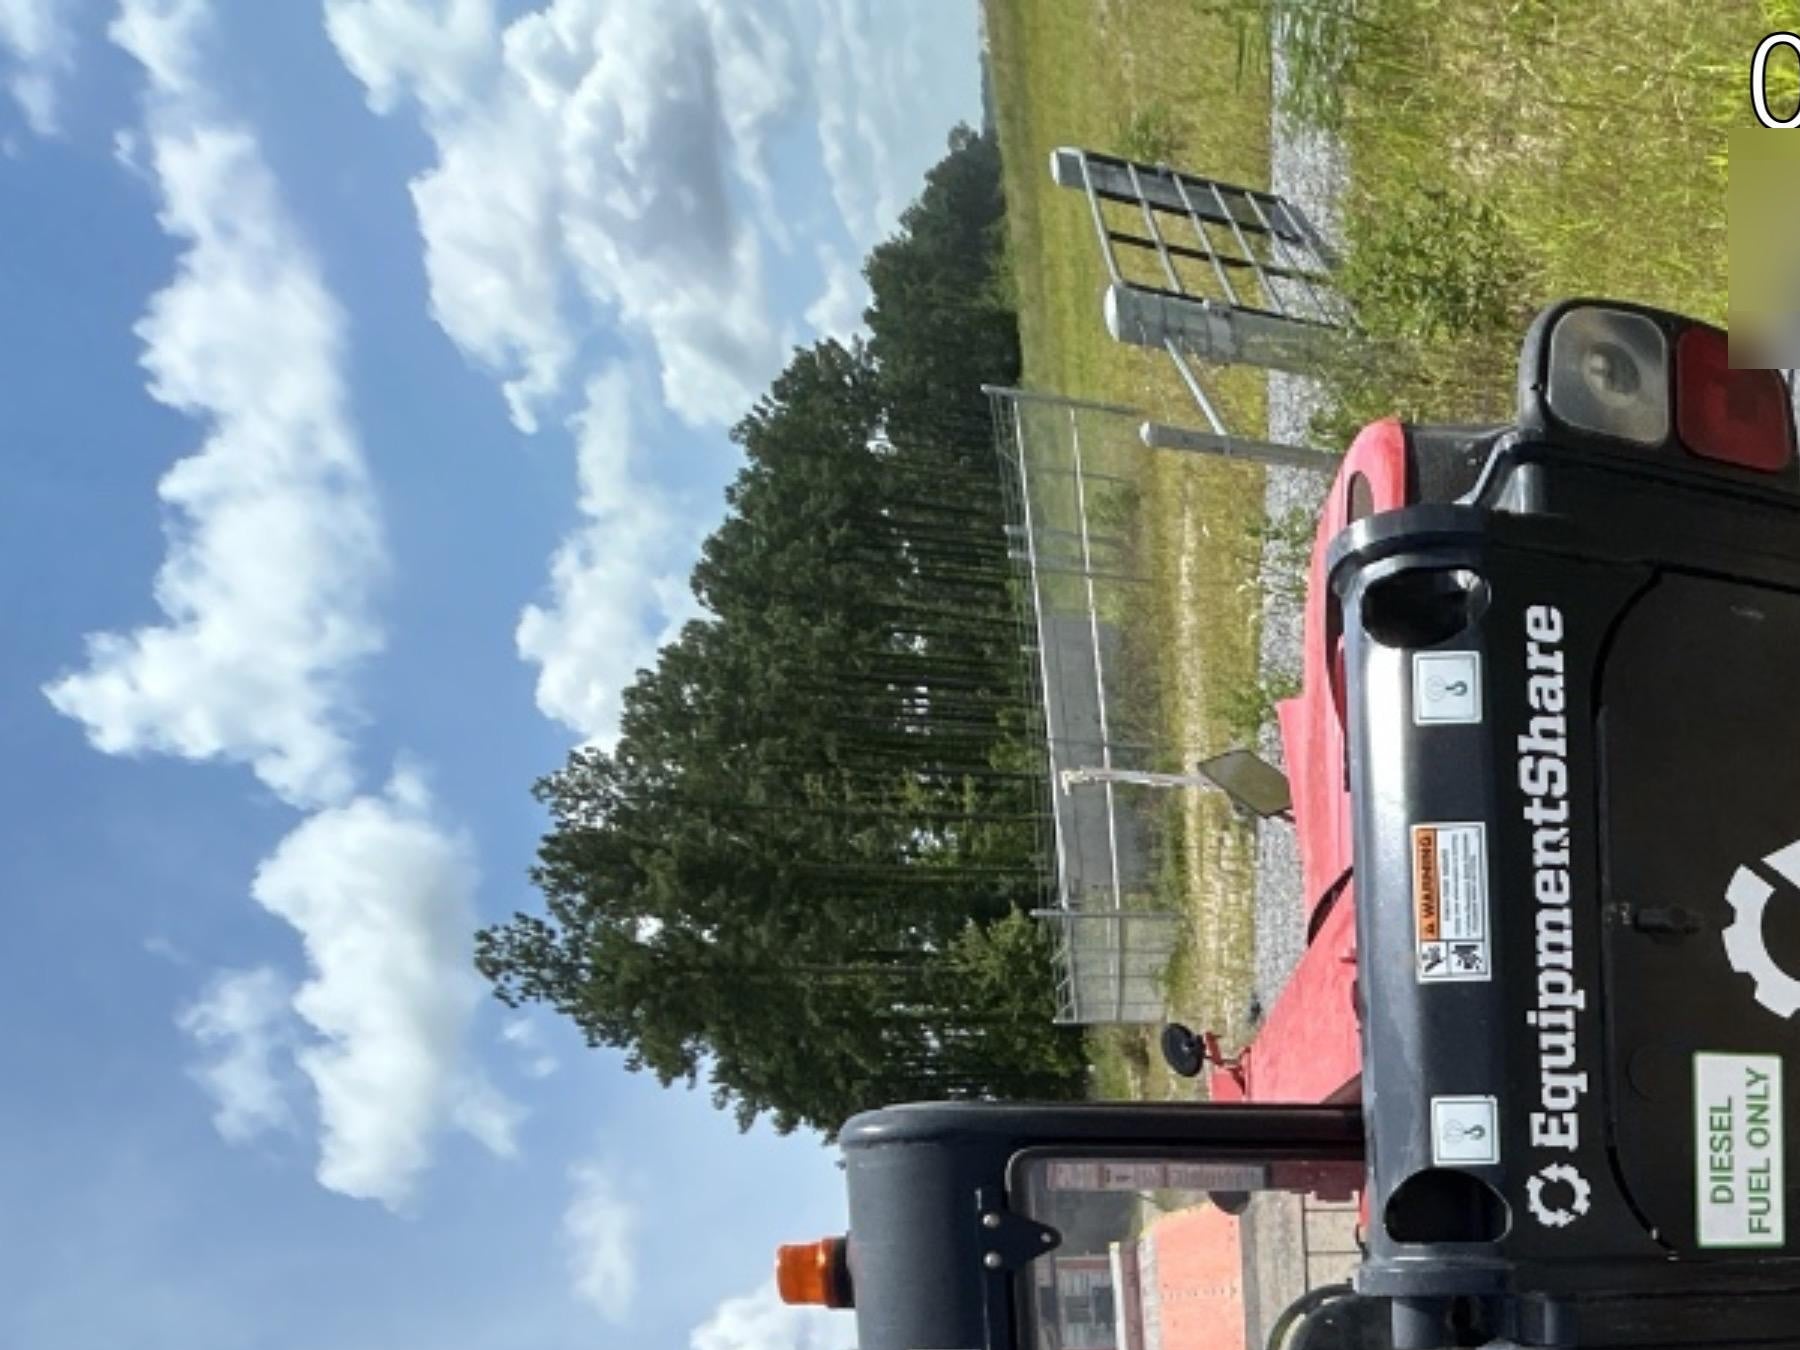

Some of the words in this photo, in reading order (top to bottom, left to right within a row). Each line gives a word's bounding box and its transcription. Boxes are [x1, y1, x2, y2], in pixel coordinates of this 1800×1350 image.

[1418, 836, 1435, 919] WARNING
[1518, 604, 1589, 1152] EquipmentShare
[1745, 1066, 1772, 1147] ONLY
[1708, 1095, 1736, 1205] DIESEL
[1748, 1157, 1772, 1235] FUEL
